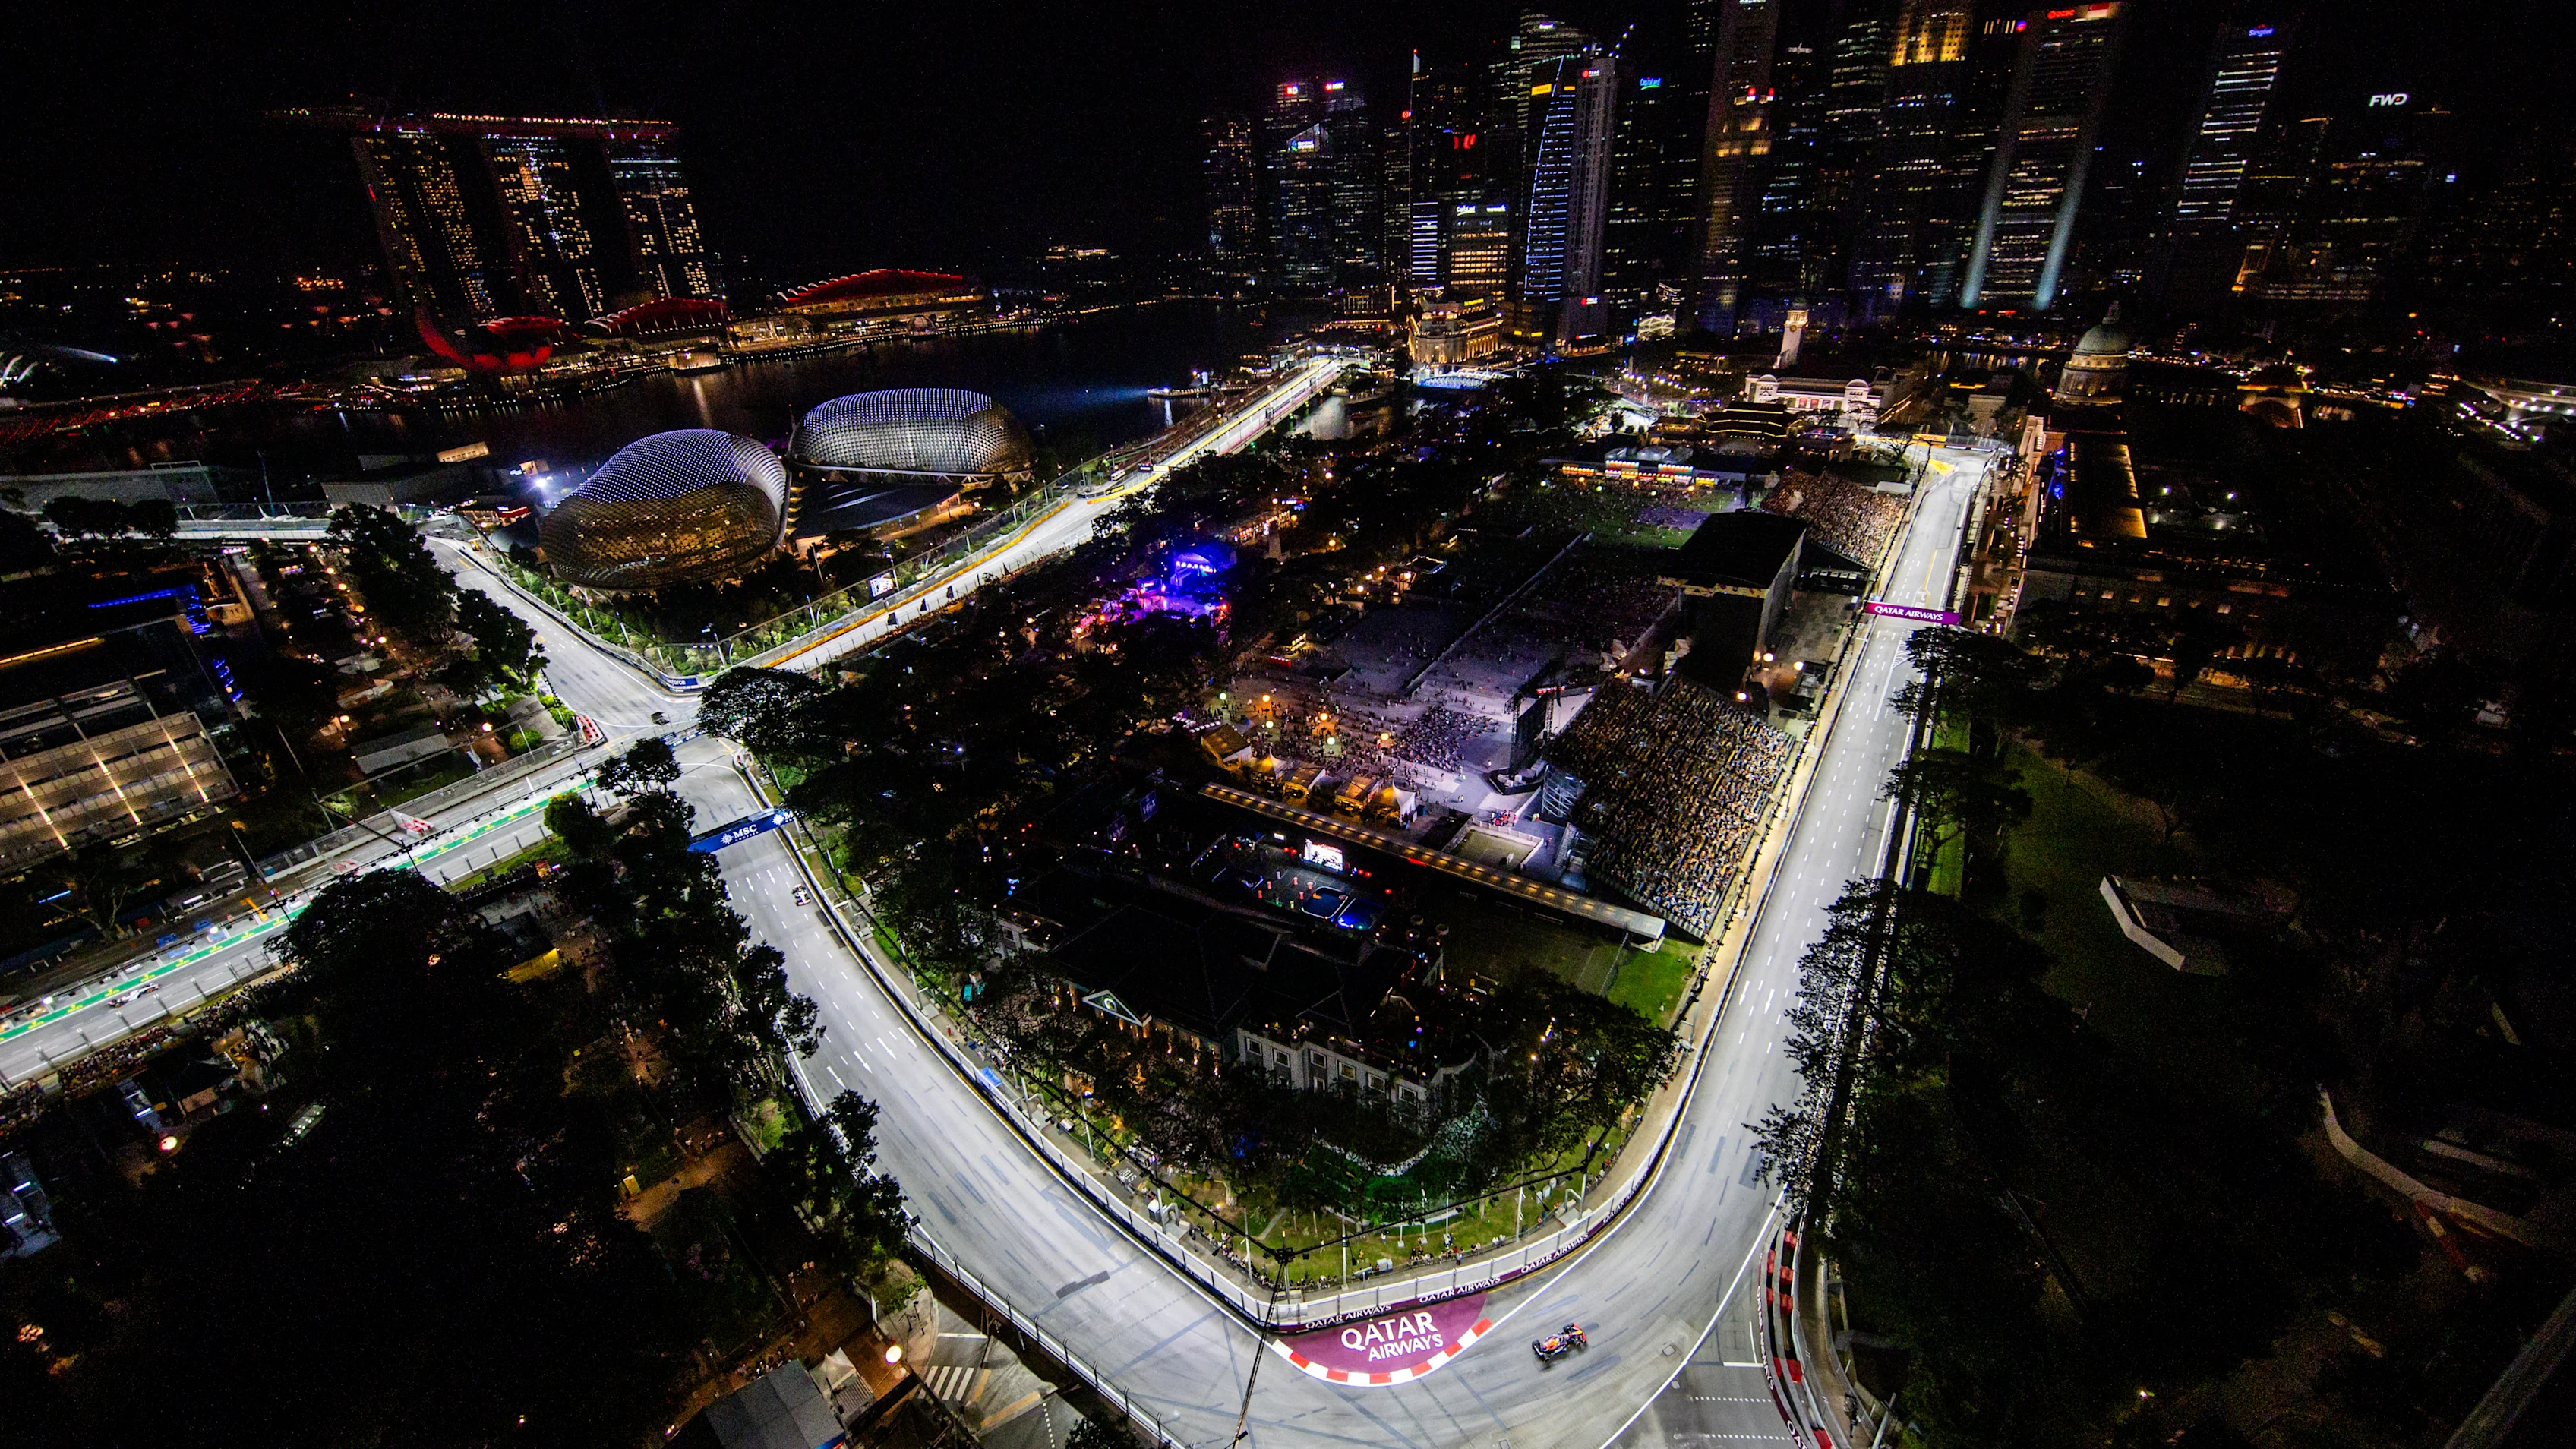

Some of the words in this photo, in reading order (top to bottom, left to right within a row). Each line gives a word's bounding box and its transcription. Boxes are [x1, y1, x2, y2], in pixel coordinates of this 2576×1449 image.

[2248, 27, 2275, 37] Singtel
[2369, 93, 2408, 106] FWD
[1874, 605, 1904, 616] QATAR
[1905, 609, 1943, 621] AIRWAYS
[733, 824, 758, 839] MSC
[1521, 1253, 1552, 1274] QATAR
[1554, 1233, 1589, 1258] AIRWAYS
[1419, 1290, 1455, 1303] QATAR
[1457, 1276, 1501, 1294] AIRWAYS
[1305, 1315, 1343, 1330] QATAR
[1345, 1304, 1392, 1320] AIRWAYS
[1341, 1312, 1438, 1352] QATAR
[1368, 1334, 1444, 1362] AIRWAYS
